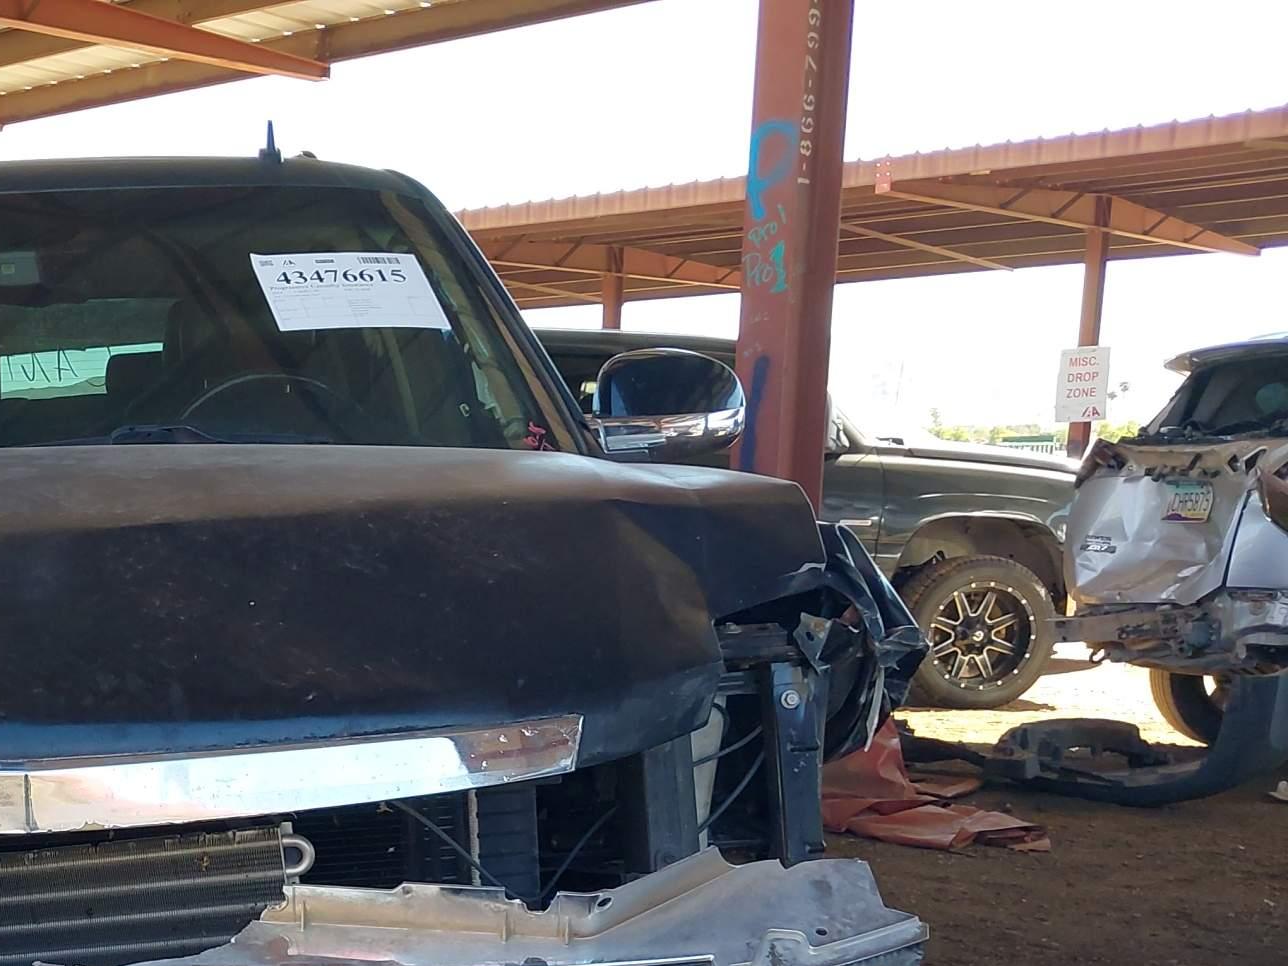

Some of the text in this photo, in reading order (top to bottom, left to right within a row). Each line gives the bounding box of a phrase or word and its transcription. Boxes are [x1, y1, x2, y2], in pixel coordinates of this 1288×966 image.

[276, 268, 408, 285] 43476615
[1068, 356, 1100, 368] MISC.
[1067, 371, 1100, 384] DROP
[1065, 386, 1097, 399] ZONE
